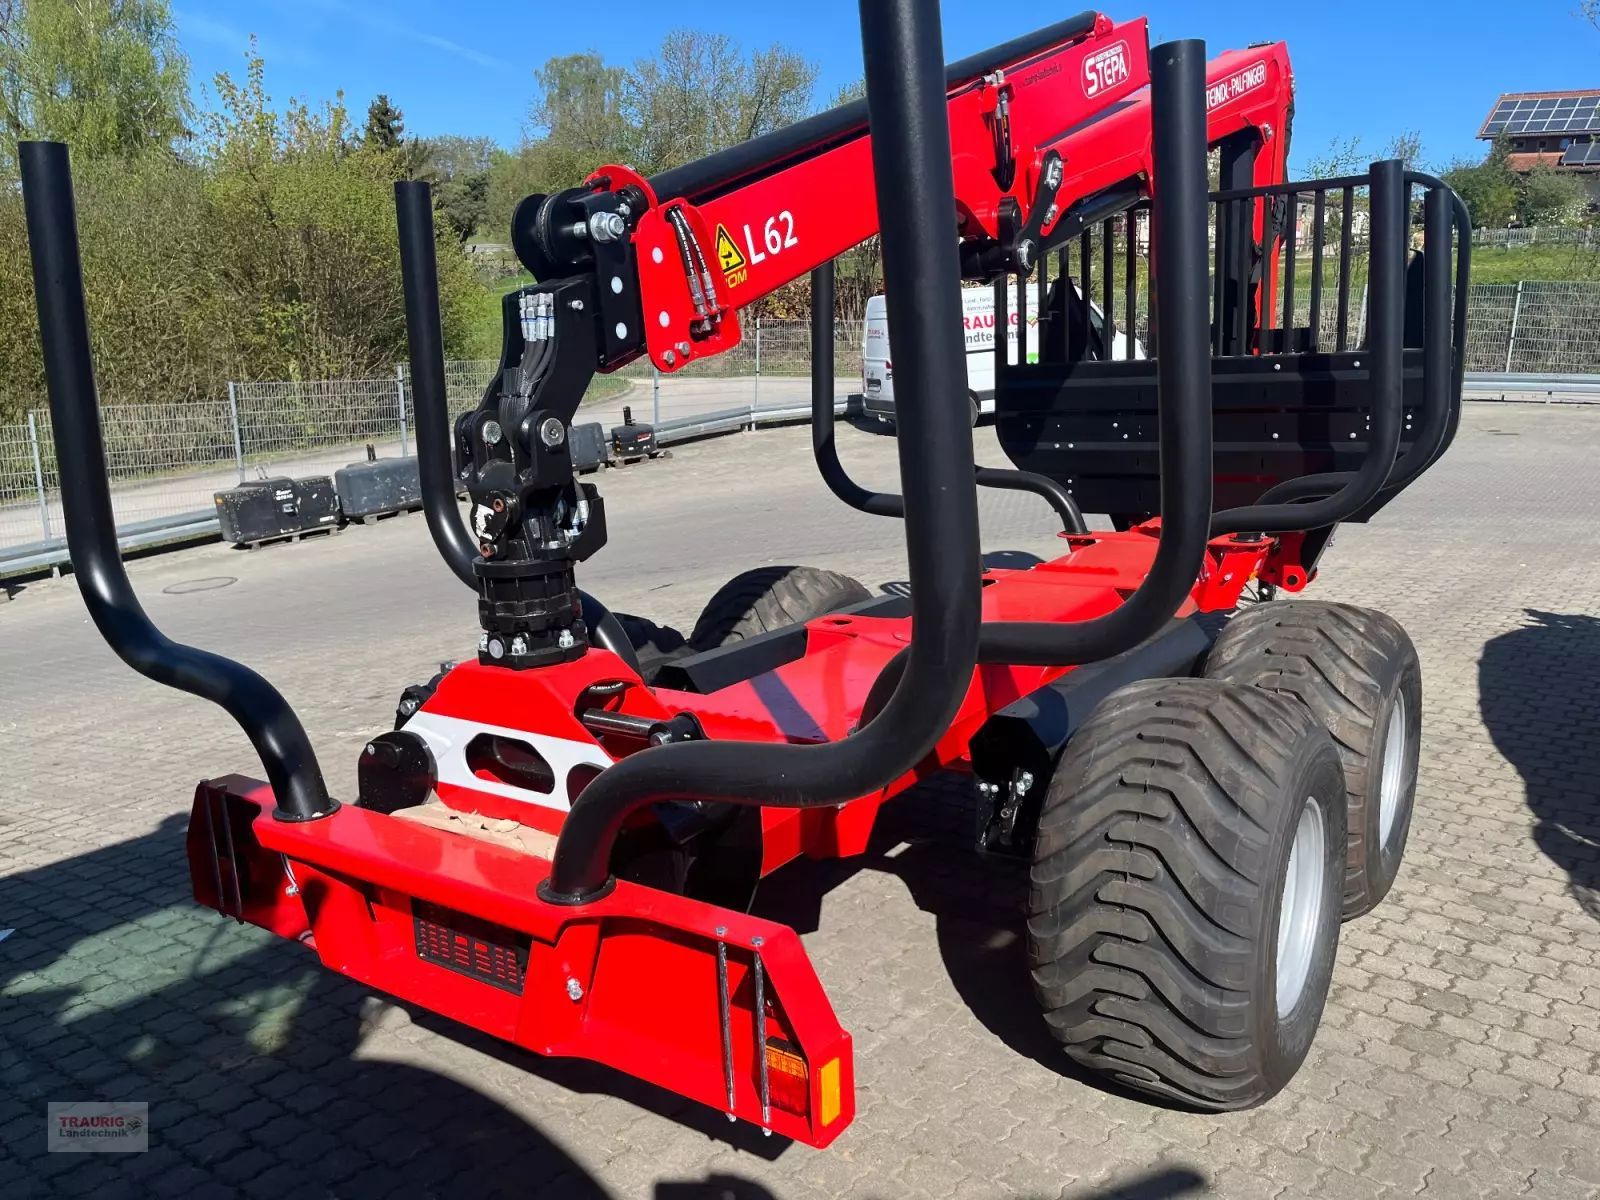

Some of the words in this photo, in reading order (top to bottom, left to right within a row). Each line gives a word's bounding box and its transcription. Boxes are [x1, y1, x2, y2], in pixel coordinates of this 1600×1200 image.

[1085, 52, 1128, 95] STEPA
[1206, 64, 1265, 110] TEINDL-PALFINGER
[743, 210, 798, 265] L62
